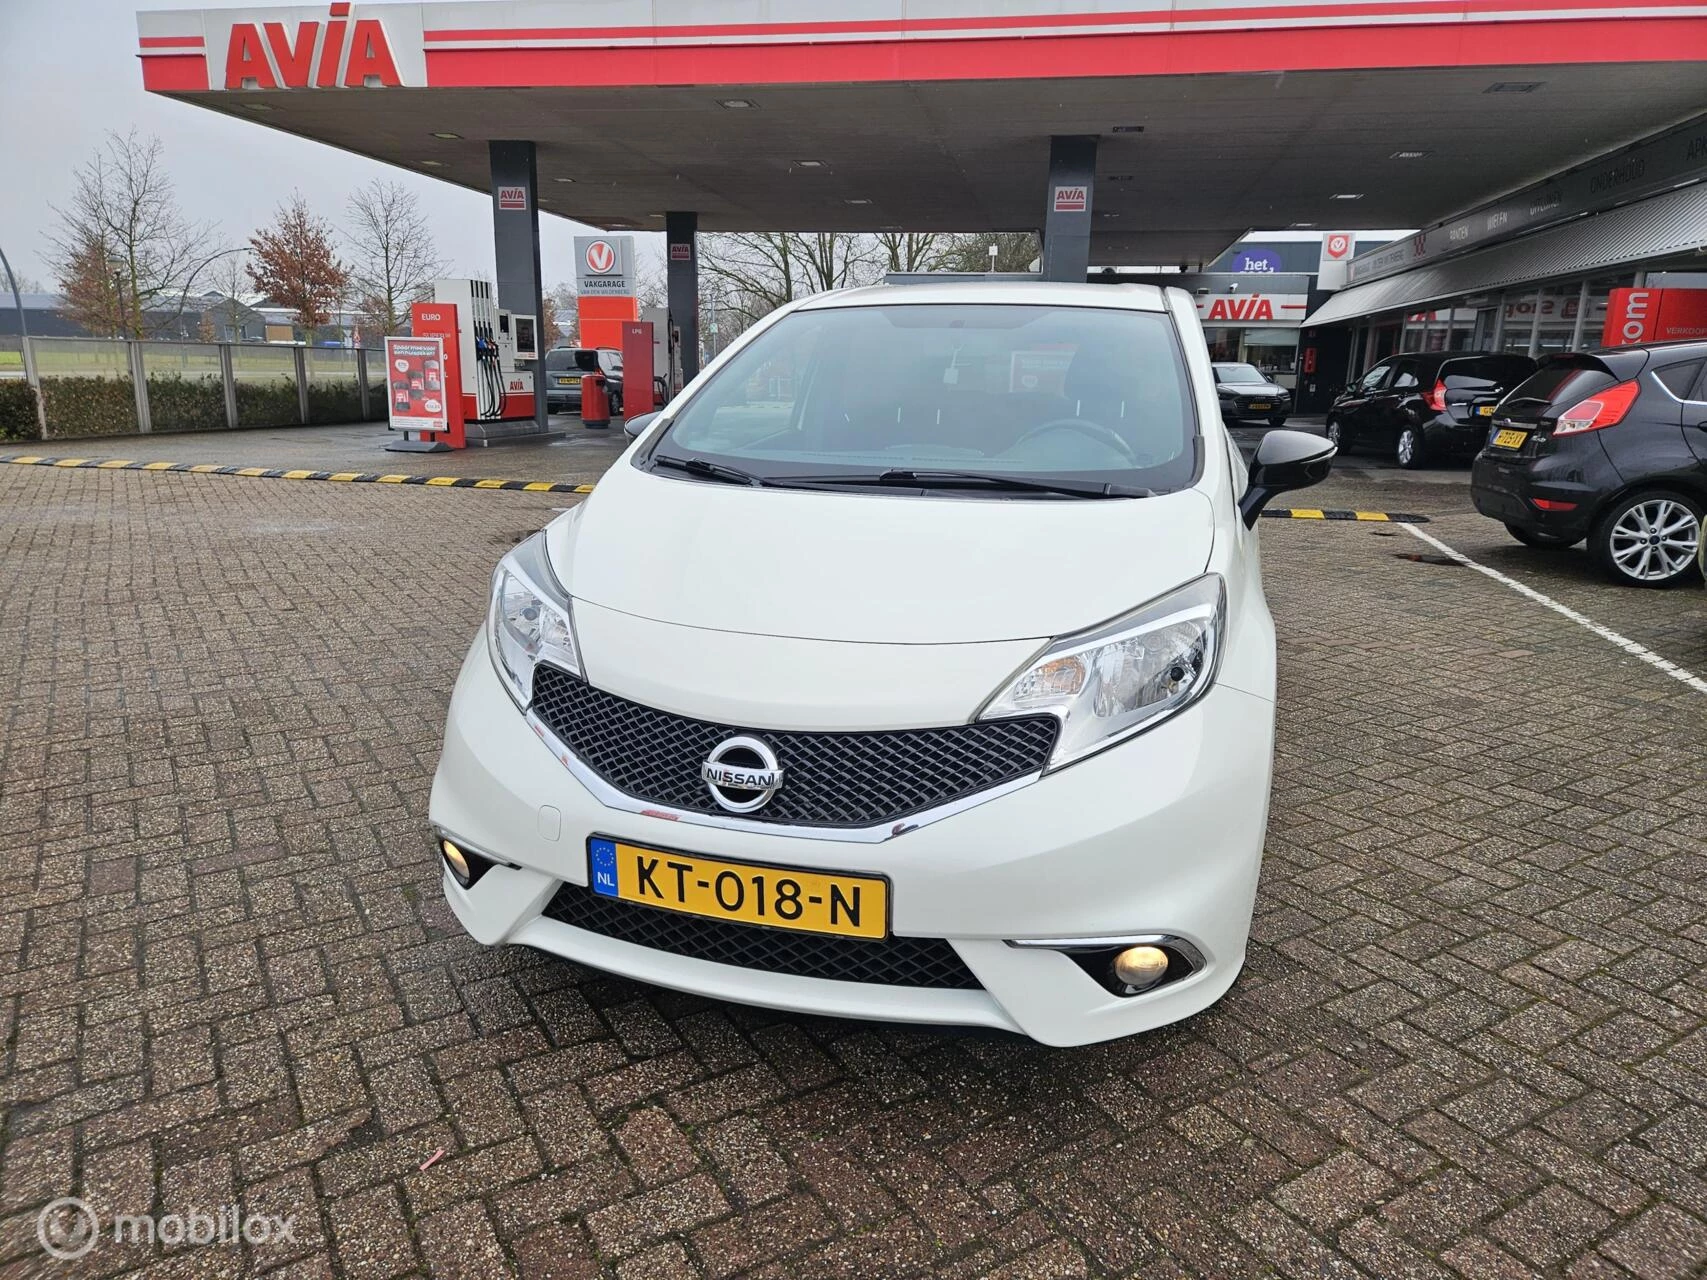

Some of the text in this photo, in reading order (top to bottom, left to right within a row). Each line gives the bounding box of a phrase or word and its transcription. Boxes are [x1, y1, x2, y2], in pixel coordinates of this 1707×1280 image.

[225, 2, 403, 89] AVIA
[500, 188, 525, 200] AVIA
[1056, 187, 1085, 200] AVIA
[1244, 257, 1269, 271] het
[584, 280, 626, 288] VAKGARAGE
[1208, 292, 1274, 320] AVIA
[421, 313, 441, 321] EURO
[509, 379, 524, 391] AVIA
[706, 768, 774, 788] NISSAN
[597, 855, 861, 928] NL KT-018-N
